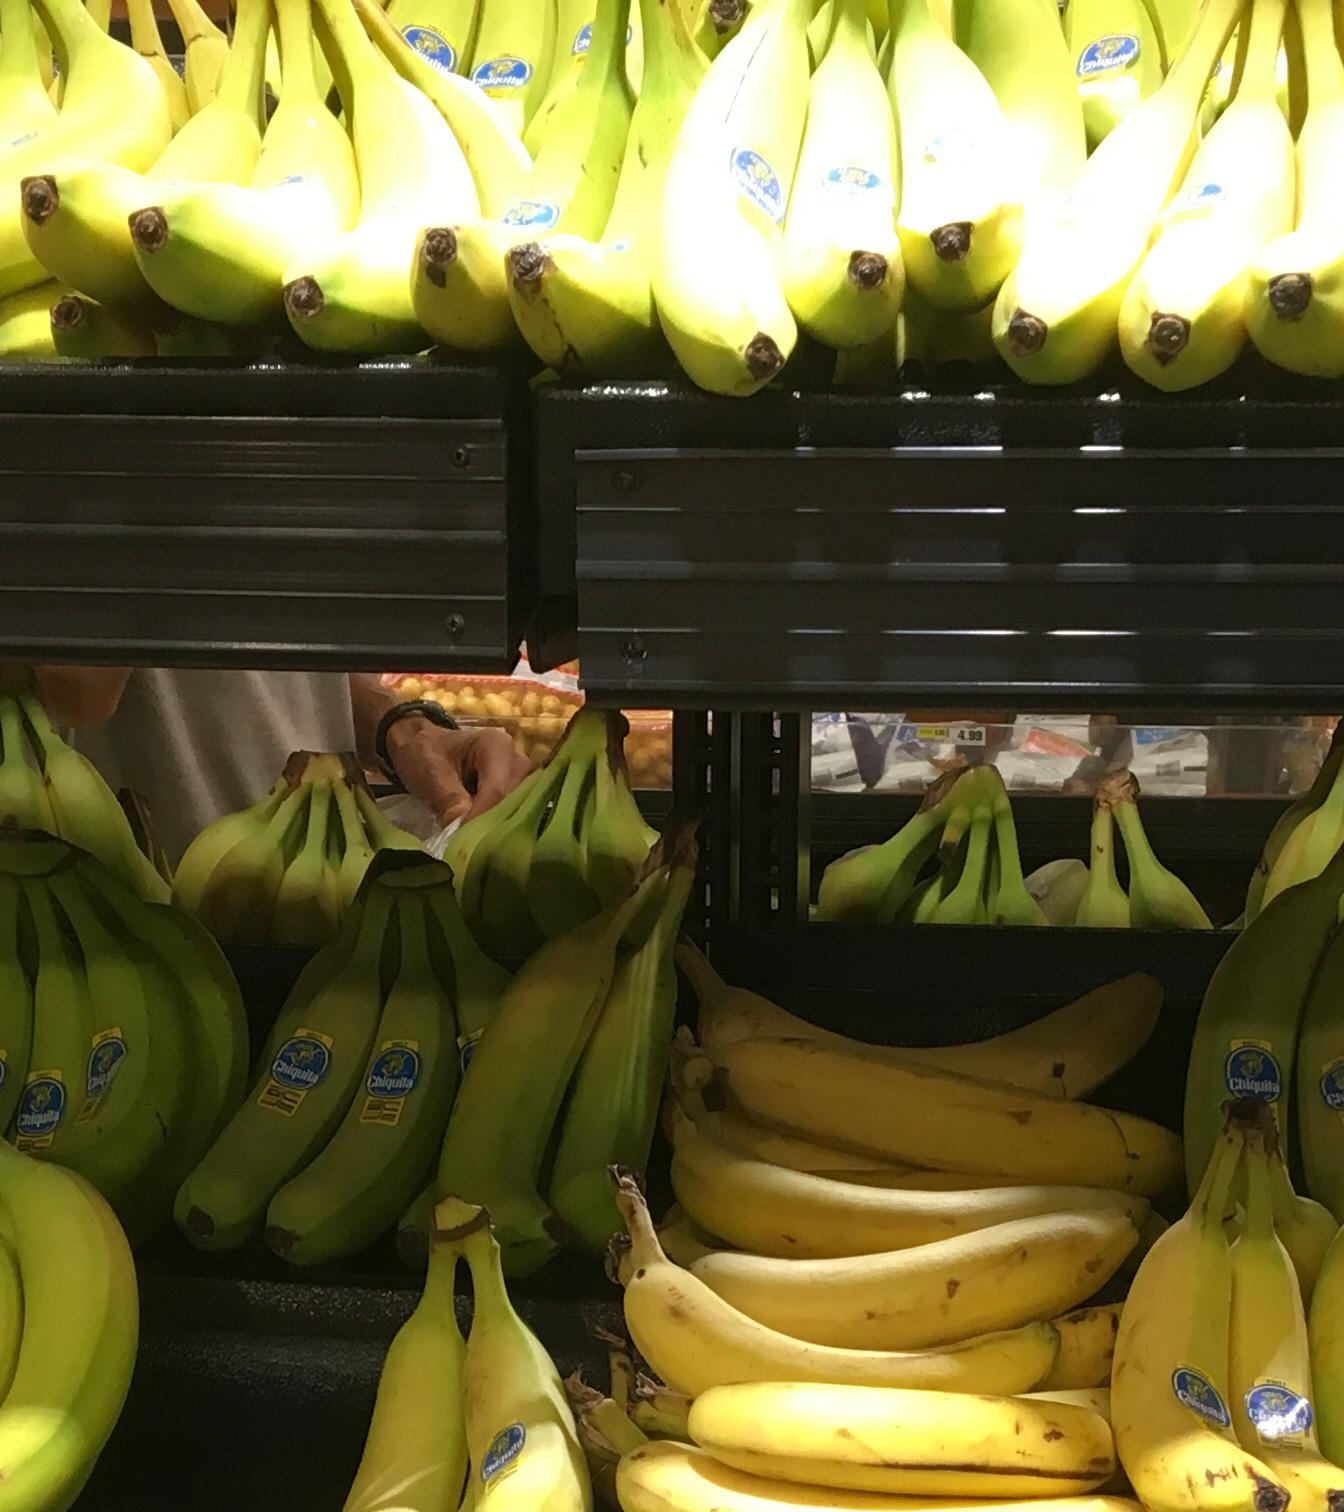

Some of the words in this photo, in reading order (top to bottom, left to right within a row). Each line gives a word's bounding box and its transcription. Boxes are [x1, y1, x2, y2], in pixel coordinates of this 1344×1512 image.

[273, 1060, 319, 1083] Chiquita
[368, 1076, 414, 1090] Chiquita
[1230, 1078, 1280, 1094] Chiquita
[18, 1111, 60, 1127] Chiquita
